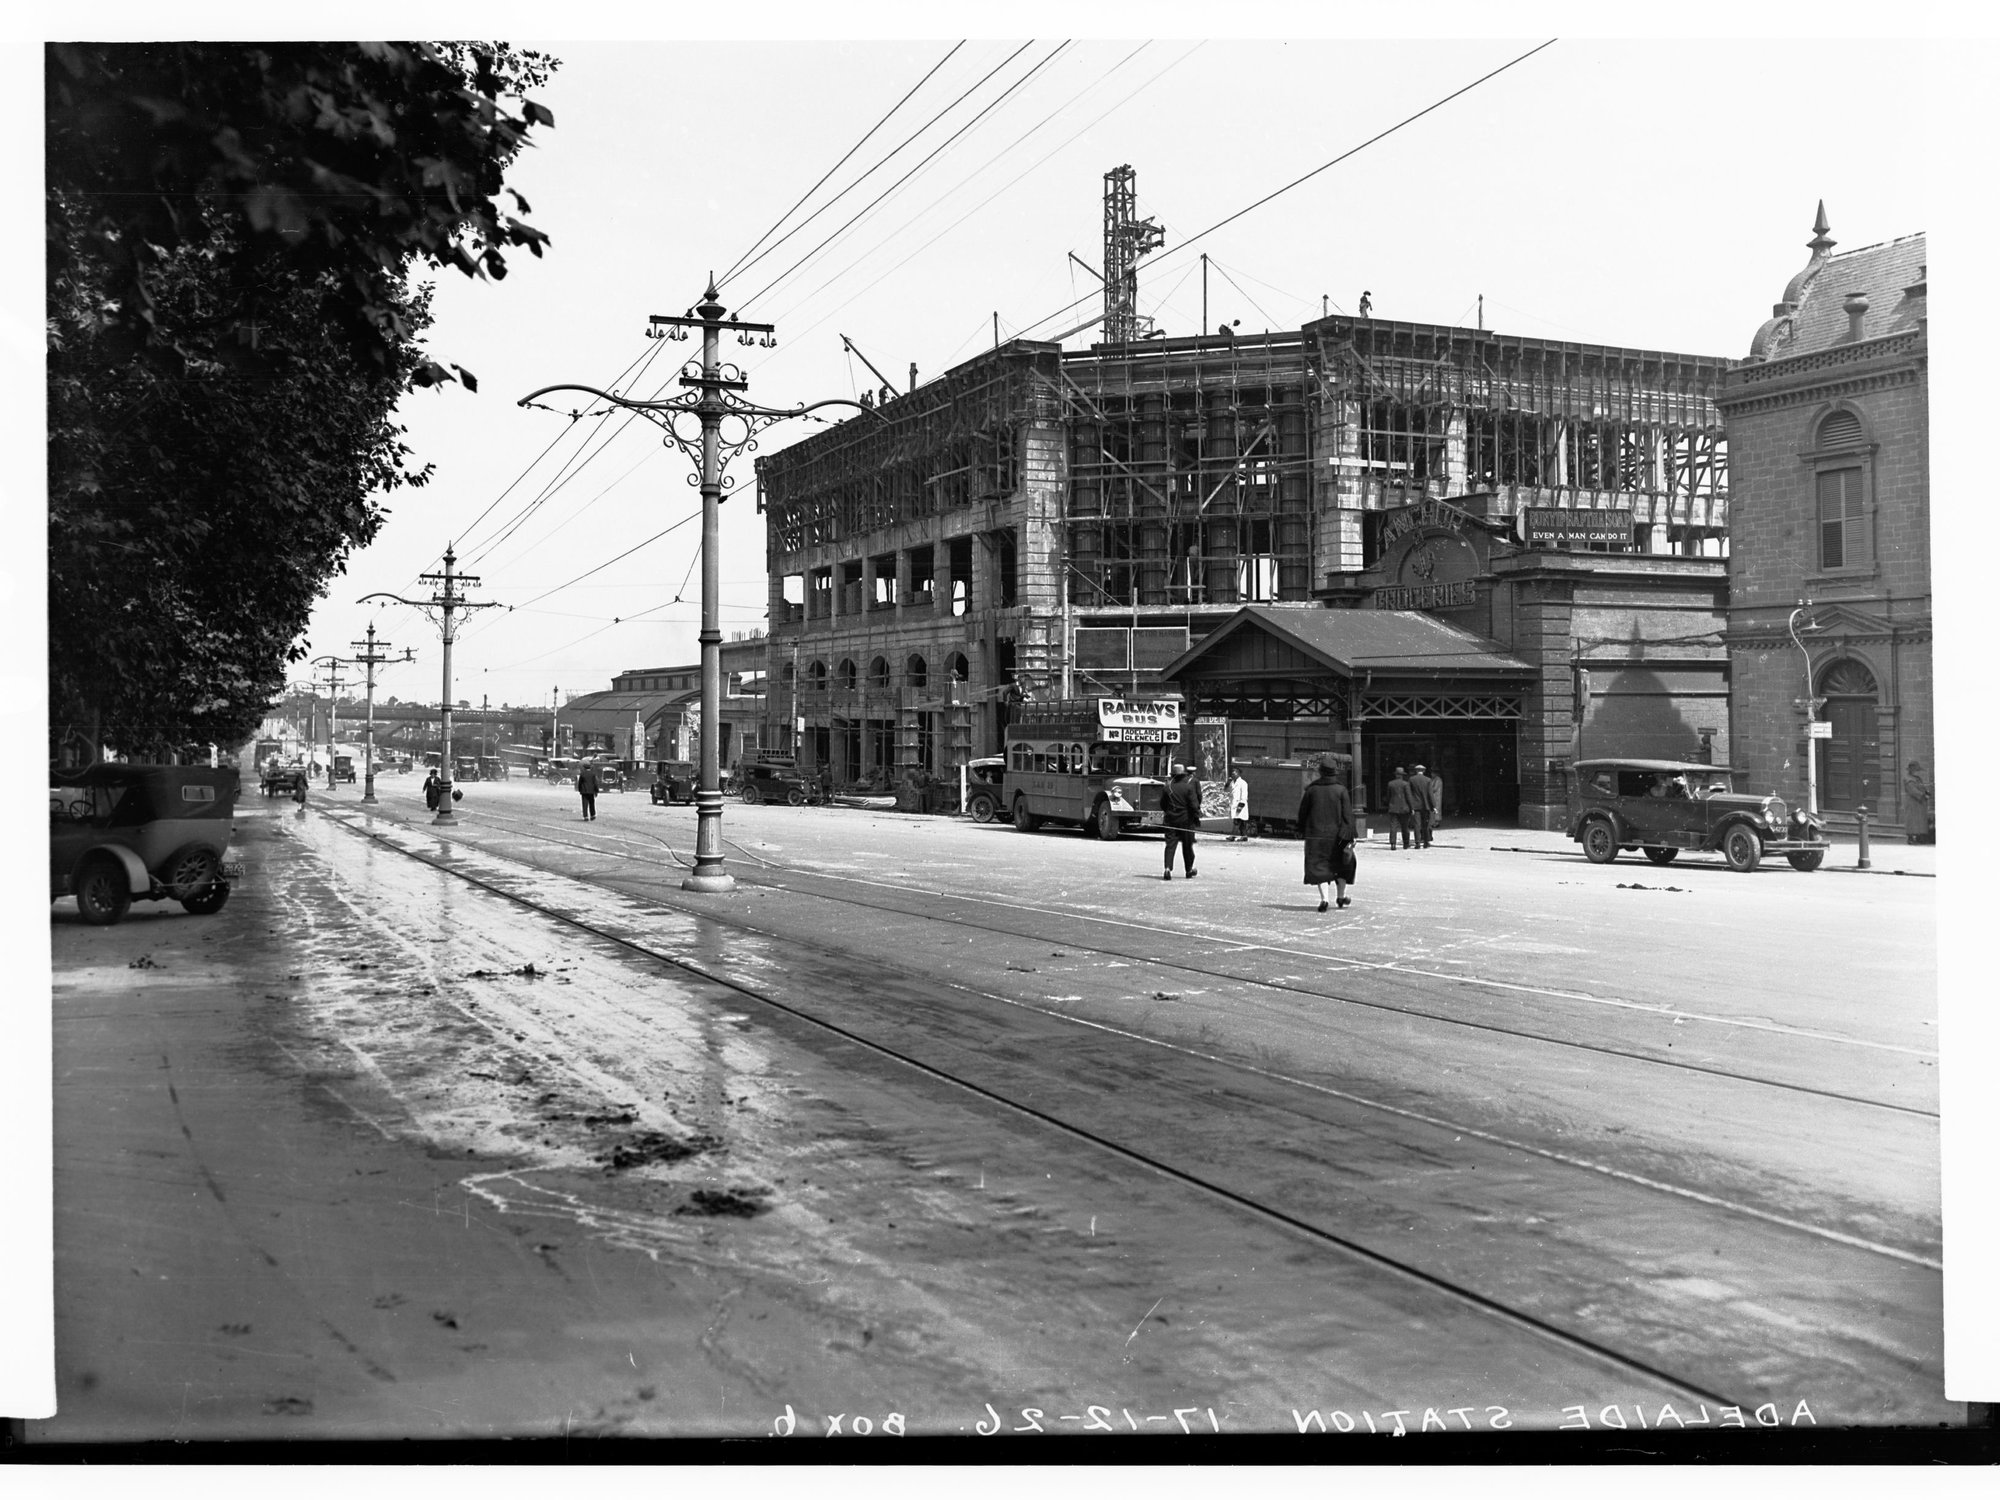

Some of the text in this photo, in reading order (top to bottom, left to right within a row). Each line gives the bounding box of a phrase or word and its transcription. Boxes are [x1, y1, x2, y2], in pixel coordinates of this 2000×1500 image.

[1384, 502, 1465, 550] ANCHOR
[1606, 512, 1631, 528] SOAP
[1533, 531, 1554, 539] EVEN
[1557, 532, 1564, 540] A
[1568, 532, 1586, 540] MAN
[1589, 532, 1606, 540] CAN
[1374, 581, 1476, 609] GROCERIES
[1103, 702, 1176, 718] RAILWAYS
[1122, 715, 1158, 724] BUS
[1166, 732, 1178, 741] 29
